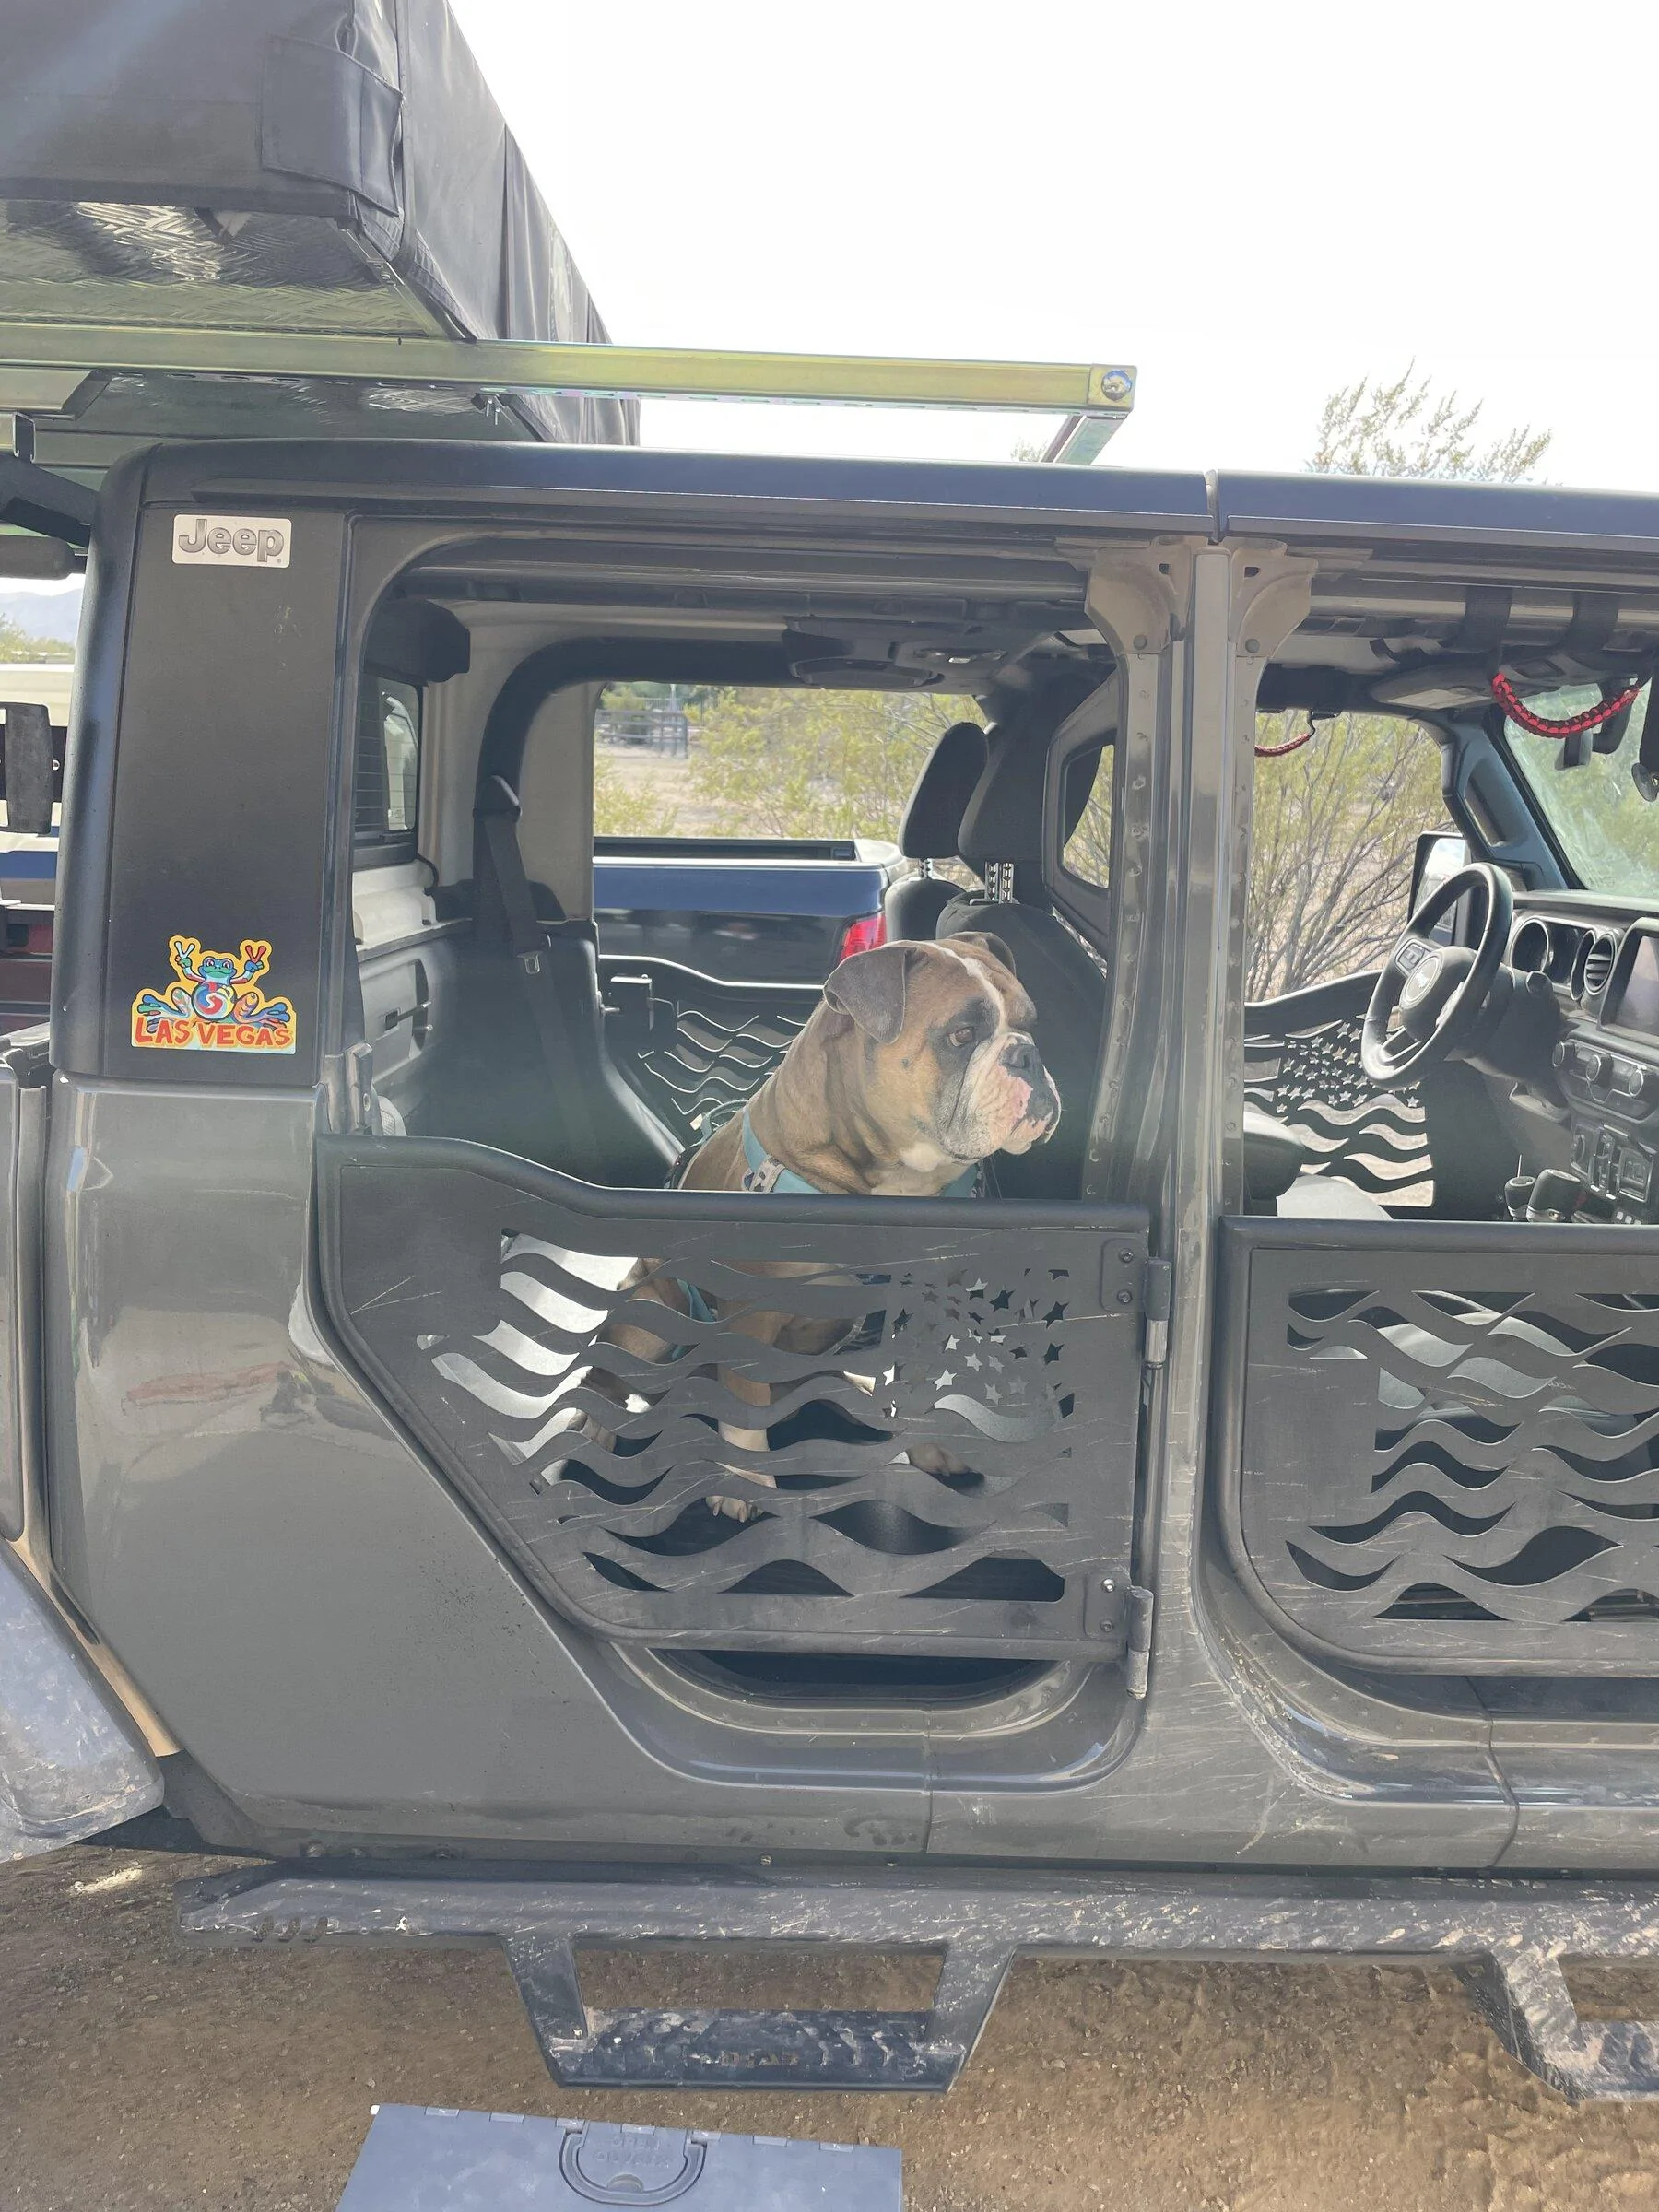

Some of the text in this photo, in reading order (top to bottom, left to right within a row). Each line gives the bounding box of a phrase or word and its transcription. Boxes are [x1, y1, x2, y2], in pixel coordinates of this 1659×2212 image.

[178, 518, 285, 563] Jeep
[134, 1016, 291, 1047] LAS VEGAS
